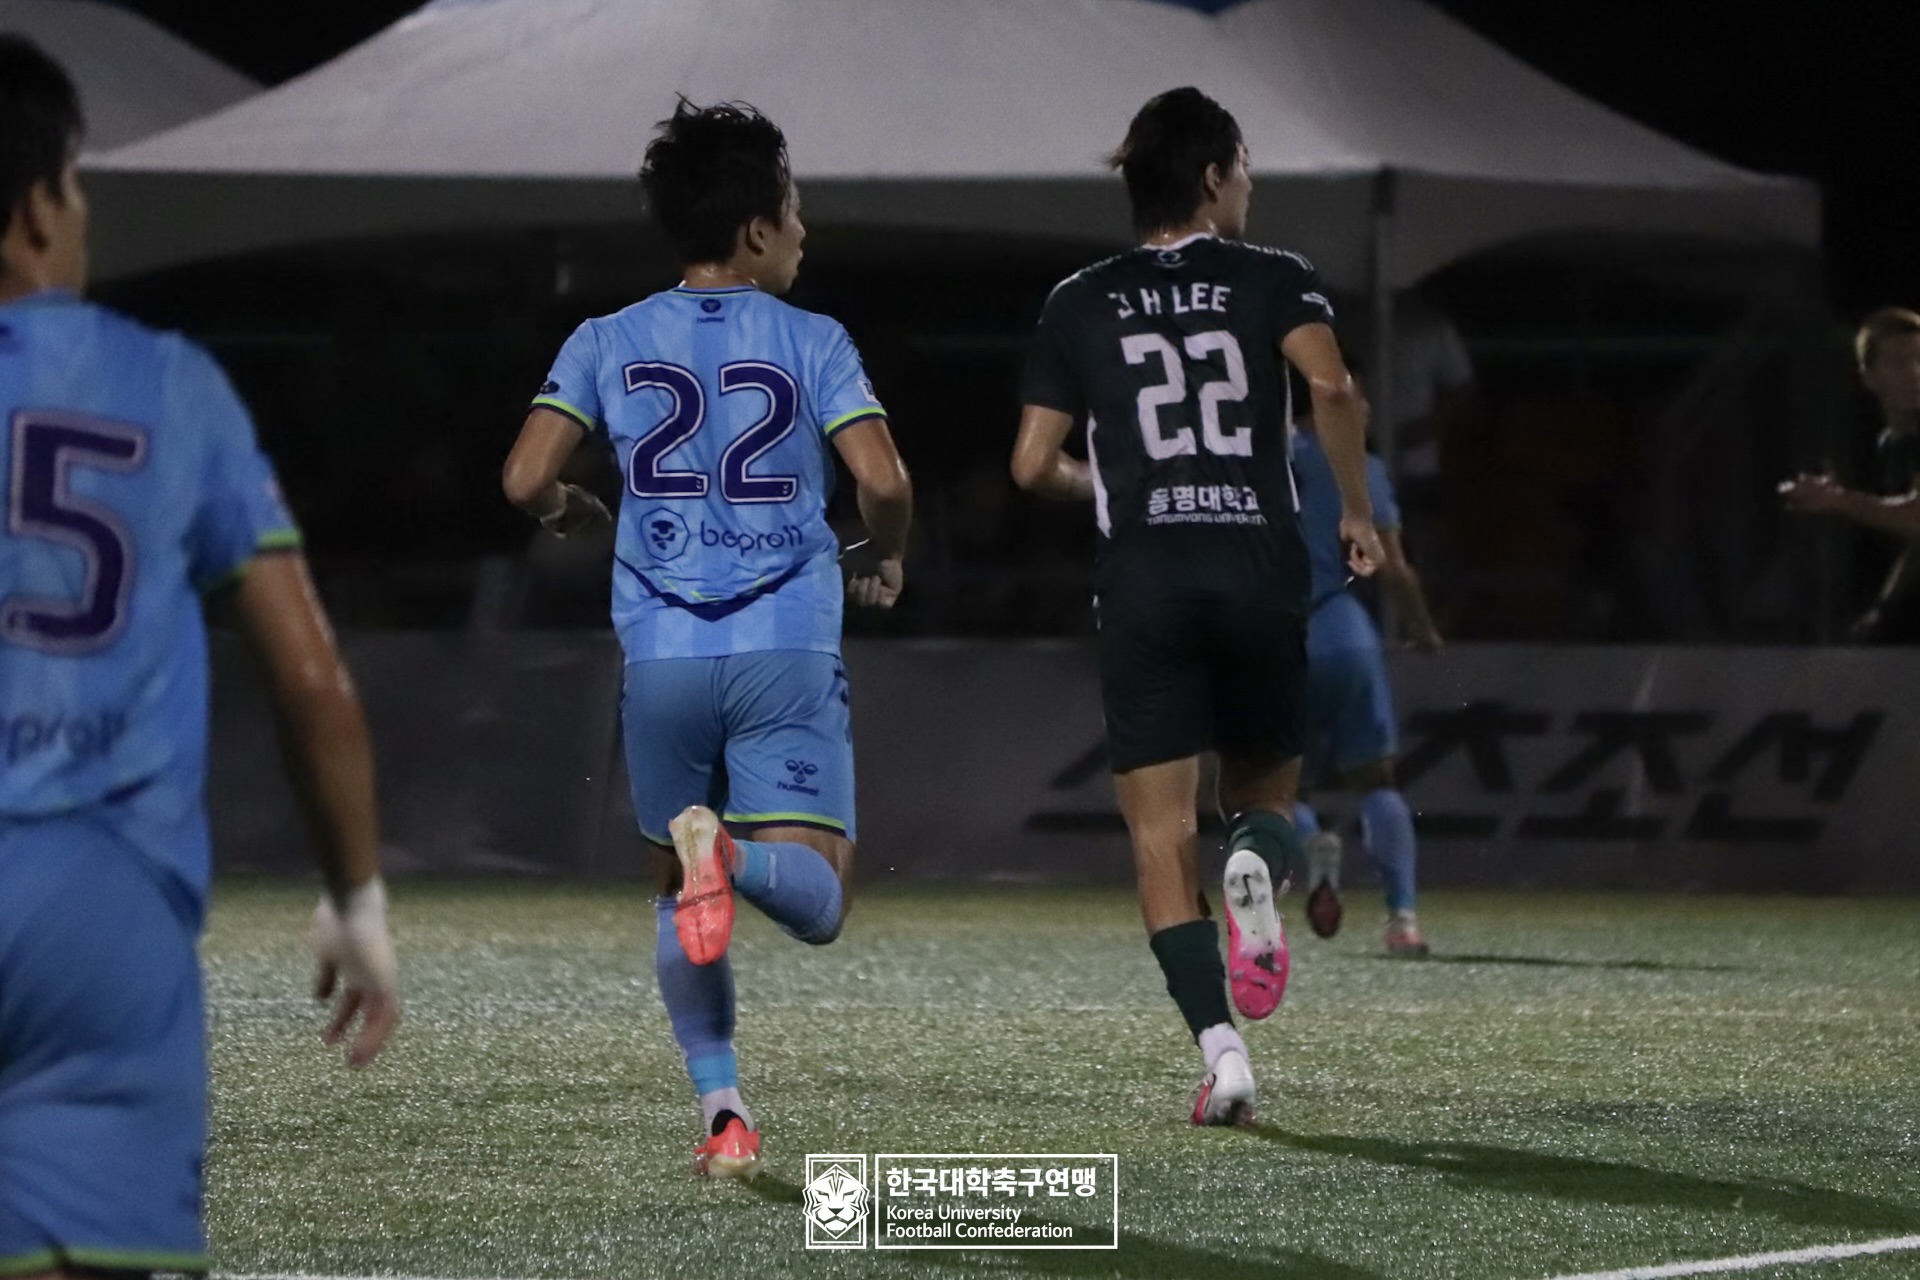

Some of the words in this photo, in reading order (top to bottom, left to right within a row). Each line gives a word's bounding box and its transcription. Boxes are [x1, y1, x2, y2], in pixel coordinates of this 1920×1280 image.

[1140, 288, 1162, 315] H
[1171, 282, 1231, 314] LEE
[623, 361, 799, 503] 22
[1120, 330, 1253, 461] 22
[0, 408, 147, 657] 5
[1023, 702, 1884, 841] 츠조선
